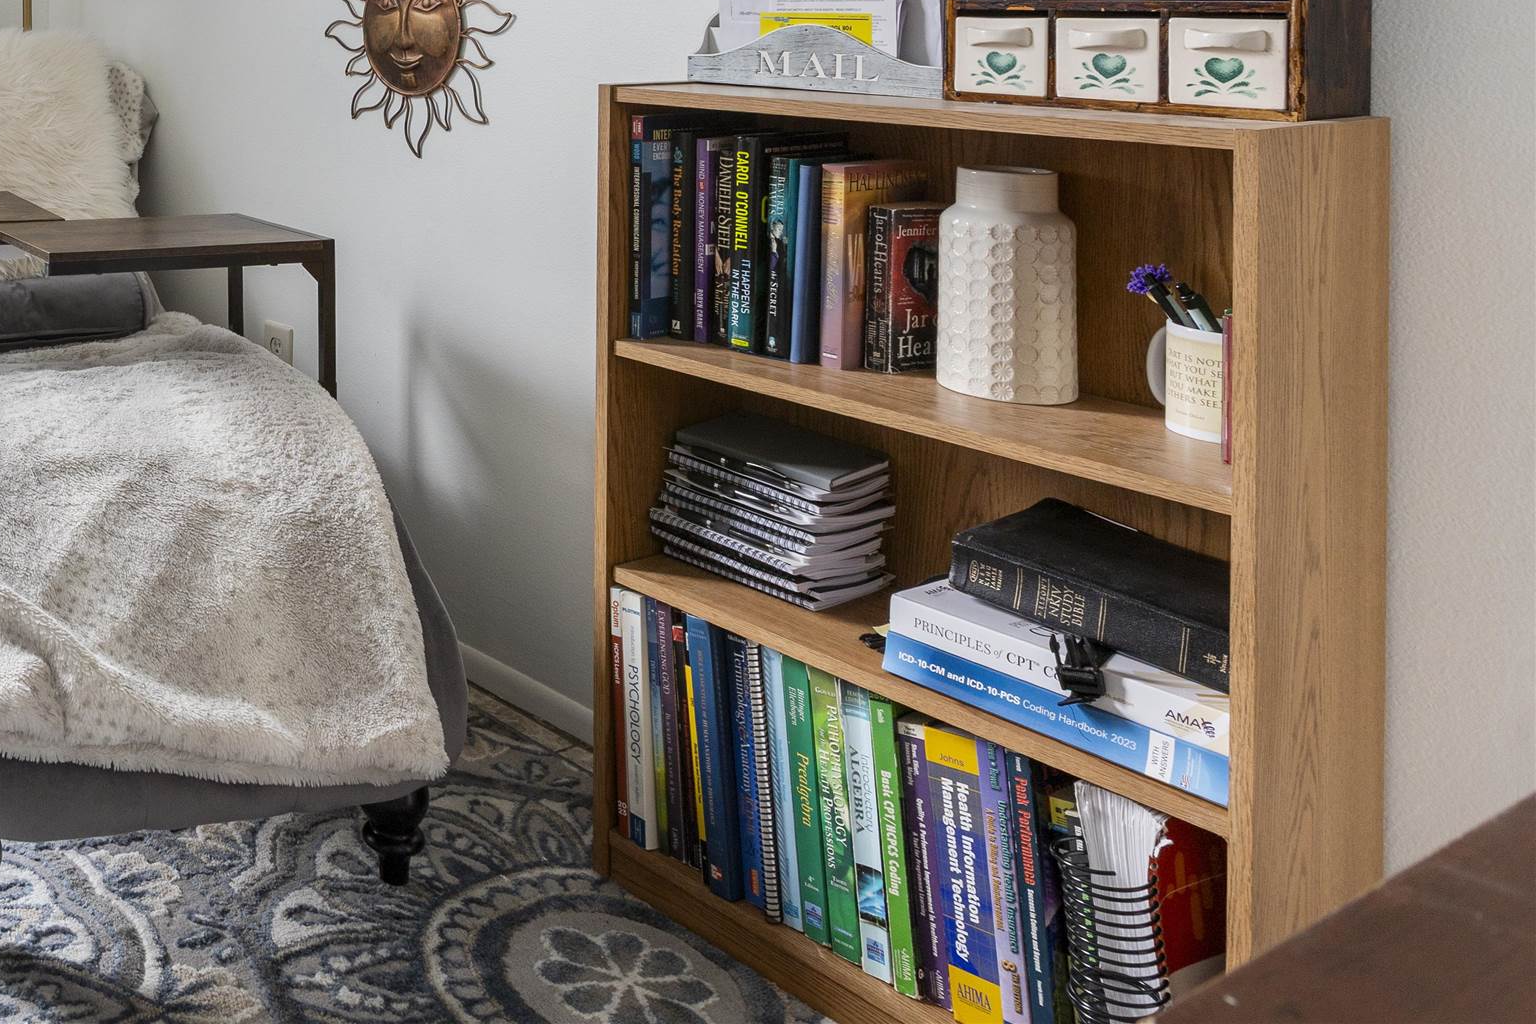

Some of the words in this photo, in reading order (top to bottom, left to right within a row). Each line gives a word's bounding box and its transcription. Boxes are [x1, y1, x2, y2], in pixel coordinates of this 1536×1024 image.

[756, 50, 881, 82] MAIL
[673, 166, 682, 185] The
[718, 156, 733, 215] DANIELLE
[736, 151, 750, 186] CAROL
[848, 172, 873, 193] HAL
[672, 189, 682, 216] Body
[769, 175, 777, 215] LEWIS
[777, 176, 785, 217] BEVERLY
[717, 215, 732, 249] STEEL
[734, 191, 749, 251] O'CONNELL
[874, 212, 888, 235] Jar
[896, 224, 937, 240] Jennifer
[672, 219, 682, 275] Revelation
[697, 219, 705, 273] MANAGEMENT
[741, 259, 751, 268] IT
[732, 269, 739, 278] IN
[873, 250, 888, 293] Hearts
[731, 281, 739, 299] THE
[740, 270, 751, 314] HAPPENS
[769, 281, 778, 317] SECRET
[731, 301, 739, 327] DARK
[903, 308, 929, 334] Jar
[1196, 357, 1223, 368] NOT
[1185, 375, 1217, 388] WHAT
[1187, 386, 1217, 398] MAKE
[1048, 585, 1063, 617] NKJV
[1060, 586, 1074, 626] STUDY
[1071, 594, 1086, 627] BIBLE
[658, 609, 668, 670] EXPERIENCING
[663, 671, 671, 695] GOD
[914, 617, 992, 656] PRINCIPLES
[993, 649, 1003, 657] of
[734, 651, 748, 726] Terminology
[788, 686, 798, 726] Ellenbogen
[796, 688, 805, 722] Bittinger
[898, 651, 946, 677] ICD-10-CM
[947, 670, 965, 685] and
[966, 676, 1021, 705] ICD-10-PCS
[1022, 699, 1057, 721] Coding
[1058, 711, 1108, 739] Handbook
[1110, 733, 1137, 751] 2023
[628, 664, 641, 764] PSYCHOLOGY
[1165, 709, 1202, 730] AMA
[740, 739, 752, 794] Anatomy
[819, 749, 831, 794] HEALTH
[939, 753, 964, 767] Johns
[1151, 745, 1160, 765] WITH
[1159, 740, 1170, 777] ANSWERS
[797, 752, 815, 828] Prealgebra
[826, 704, 848, 848] PATHOPHYSIOLOGY
[848, 745, 864, 834] ALGEBRA
[861, 753, 873, 833] Introductory
[881, 770, 894, 798] Basic
[1014, 776, 1030, 806] Peak
[915, 798, 925, 822] Quality
[956, 781, 973, 832] Health
[822, 796, 836, 869] PROFESSIONS
[883, 800, 899, 858] CPT/HCPCS
[941, 777, 964, 874] Management
[998, 800, 1013, 870] Understanding
[920, 829, 929, 869] Performance
[1019, 809, 1036, 886] Performance
[888, 860, 902, 897] Coding
[923, 870, 935, 914] Improvement
[962, 834, 981, 924] Information
[1004, 872, 1016, 904] Health
[1026, 889, 1035, 912] Success
[951, 878, 970, 963] Technology
[1007, 906, 1019, 954] Insurance
[1030, 918, 1039, 940] College
[929, 922, 938, 957] Healthcare
[1032, 940, 1040, 951] and
[902, 948, 912, 981] AHIMA
[1033, 951, 1042, 973] Beyond
[957, 982, 992, 1011] AHIMA
